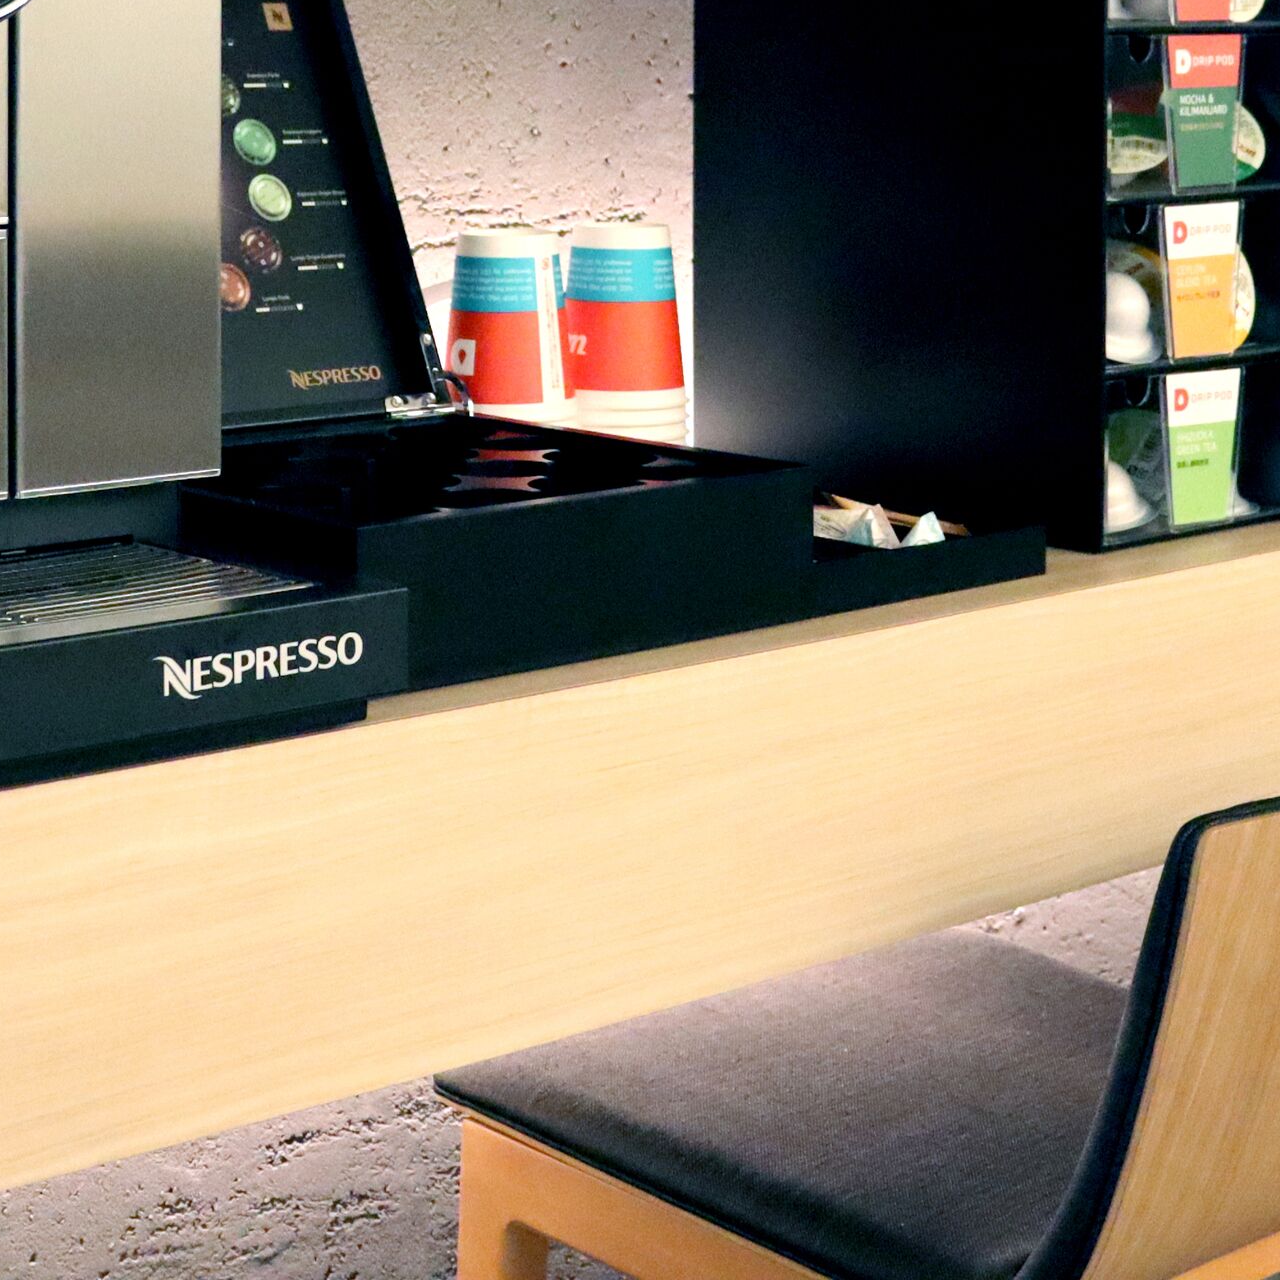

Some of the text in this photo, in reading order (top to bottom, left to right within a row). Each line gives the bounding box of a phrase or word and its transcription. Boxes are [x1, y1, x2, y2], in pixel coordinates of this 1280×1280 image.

[1192, 56, 1214, 67] DRIP
[1216, 54, 1234, 66] POD
[1179, 94, 1207, 105] MOCHA
[288, 365, 382, 390] NESPRESSO
[152, 631, 364, 700] NESPRESSO
